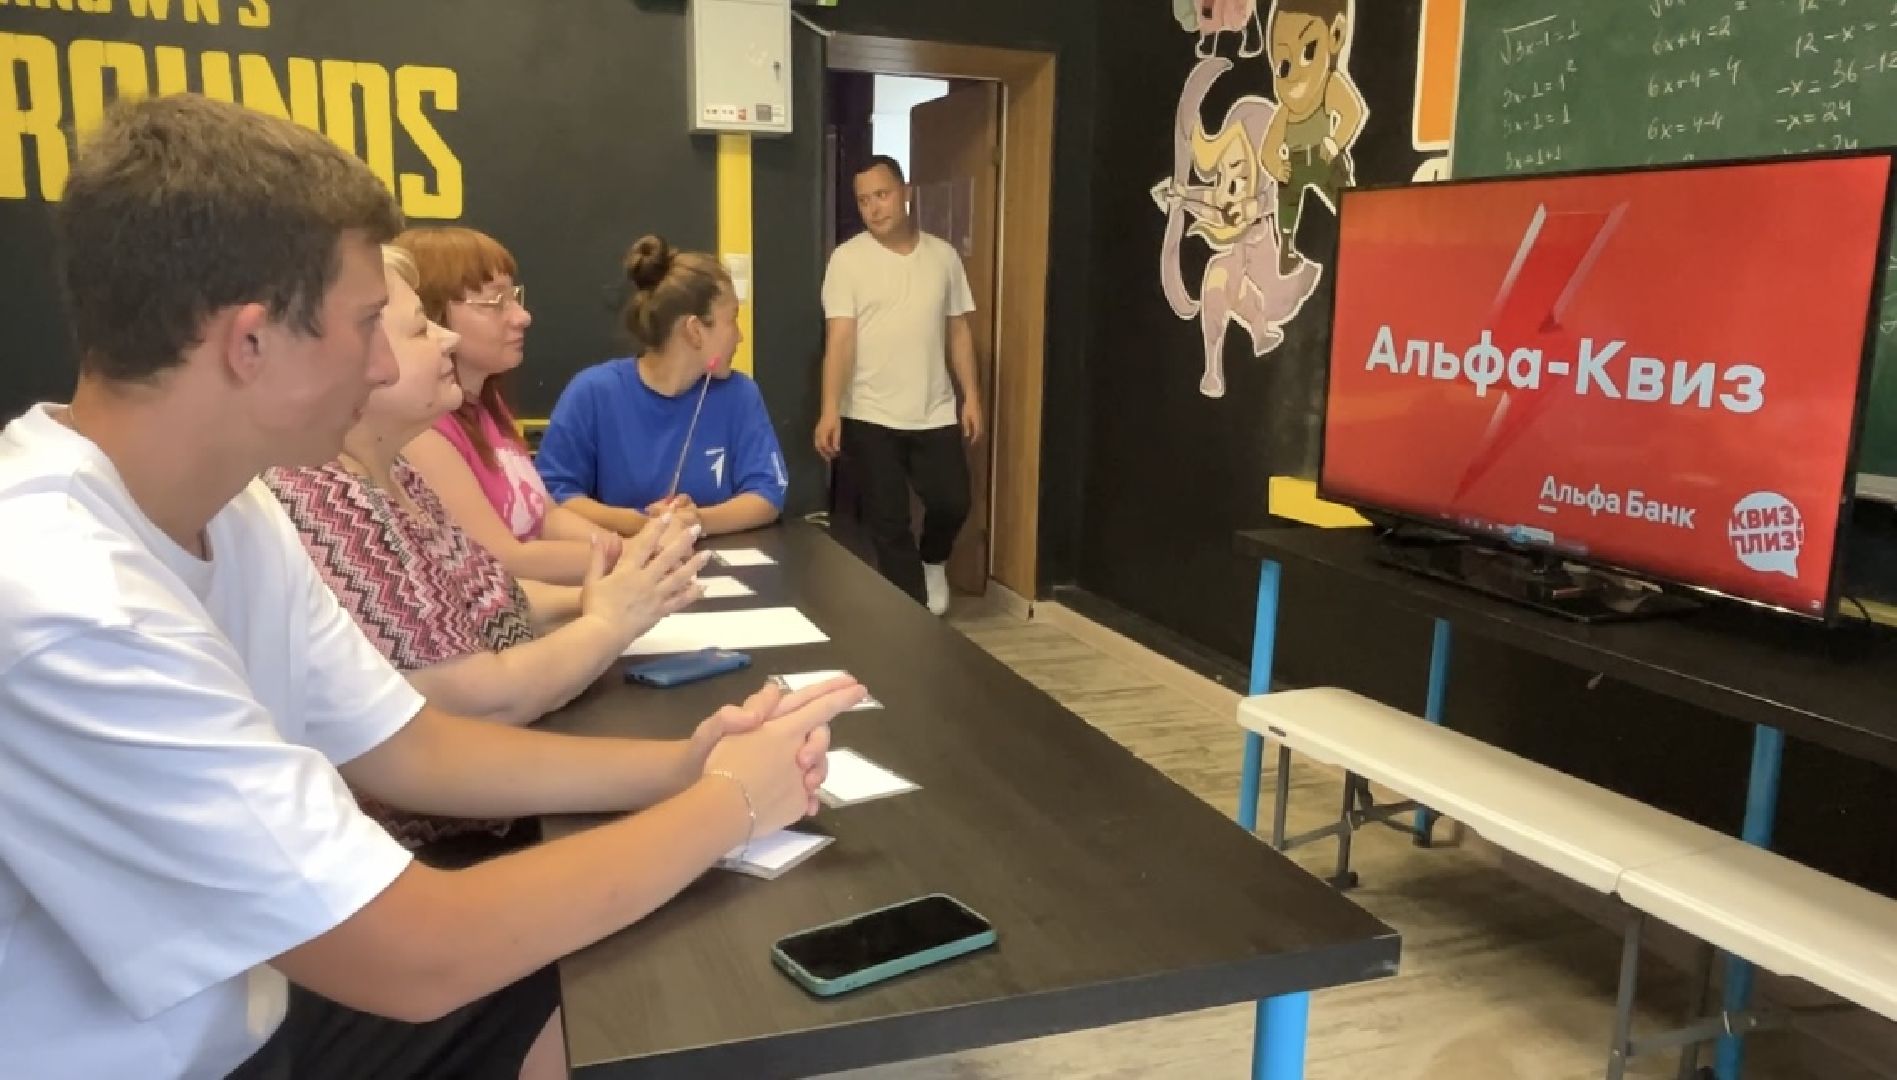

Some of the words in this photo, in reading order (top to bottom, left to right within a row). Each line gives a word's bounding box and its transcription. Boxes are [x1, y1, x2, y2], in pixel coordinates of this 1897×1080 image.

[1365, 325, 1766, 413] Альфа-Квиз
[1539, 475, 1621, 517] Альфа
[1625, 491, 1696, 530] Банк
